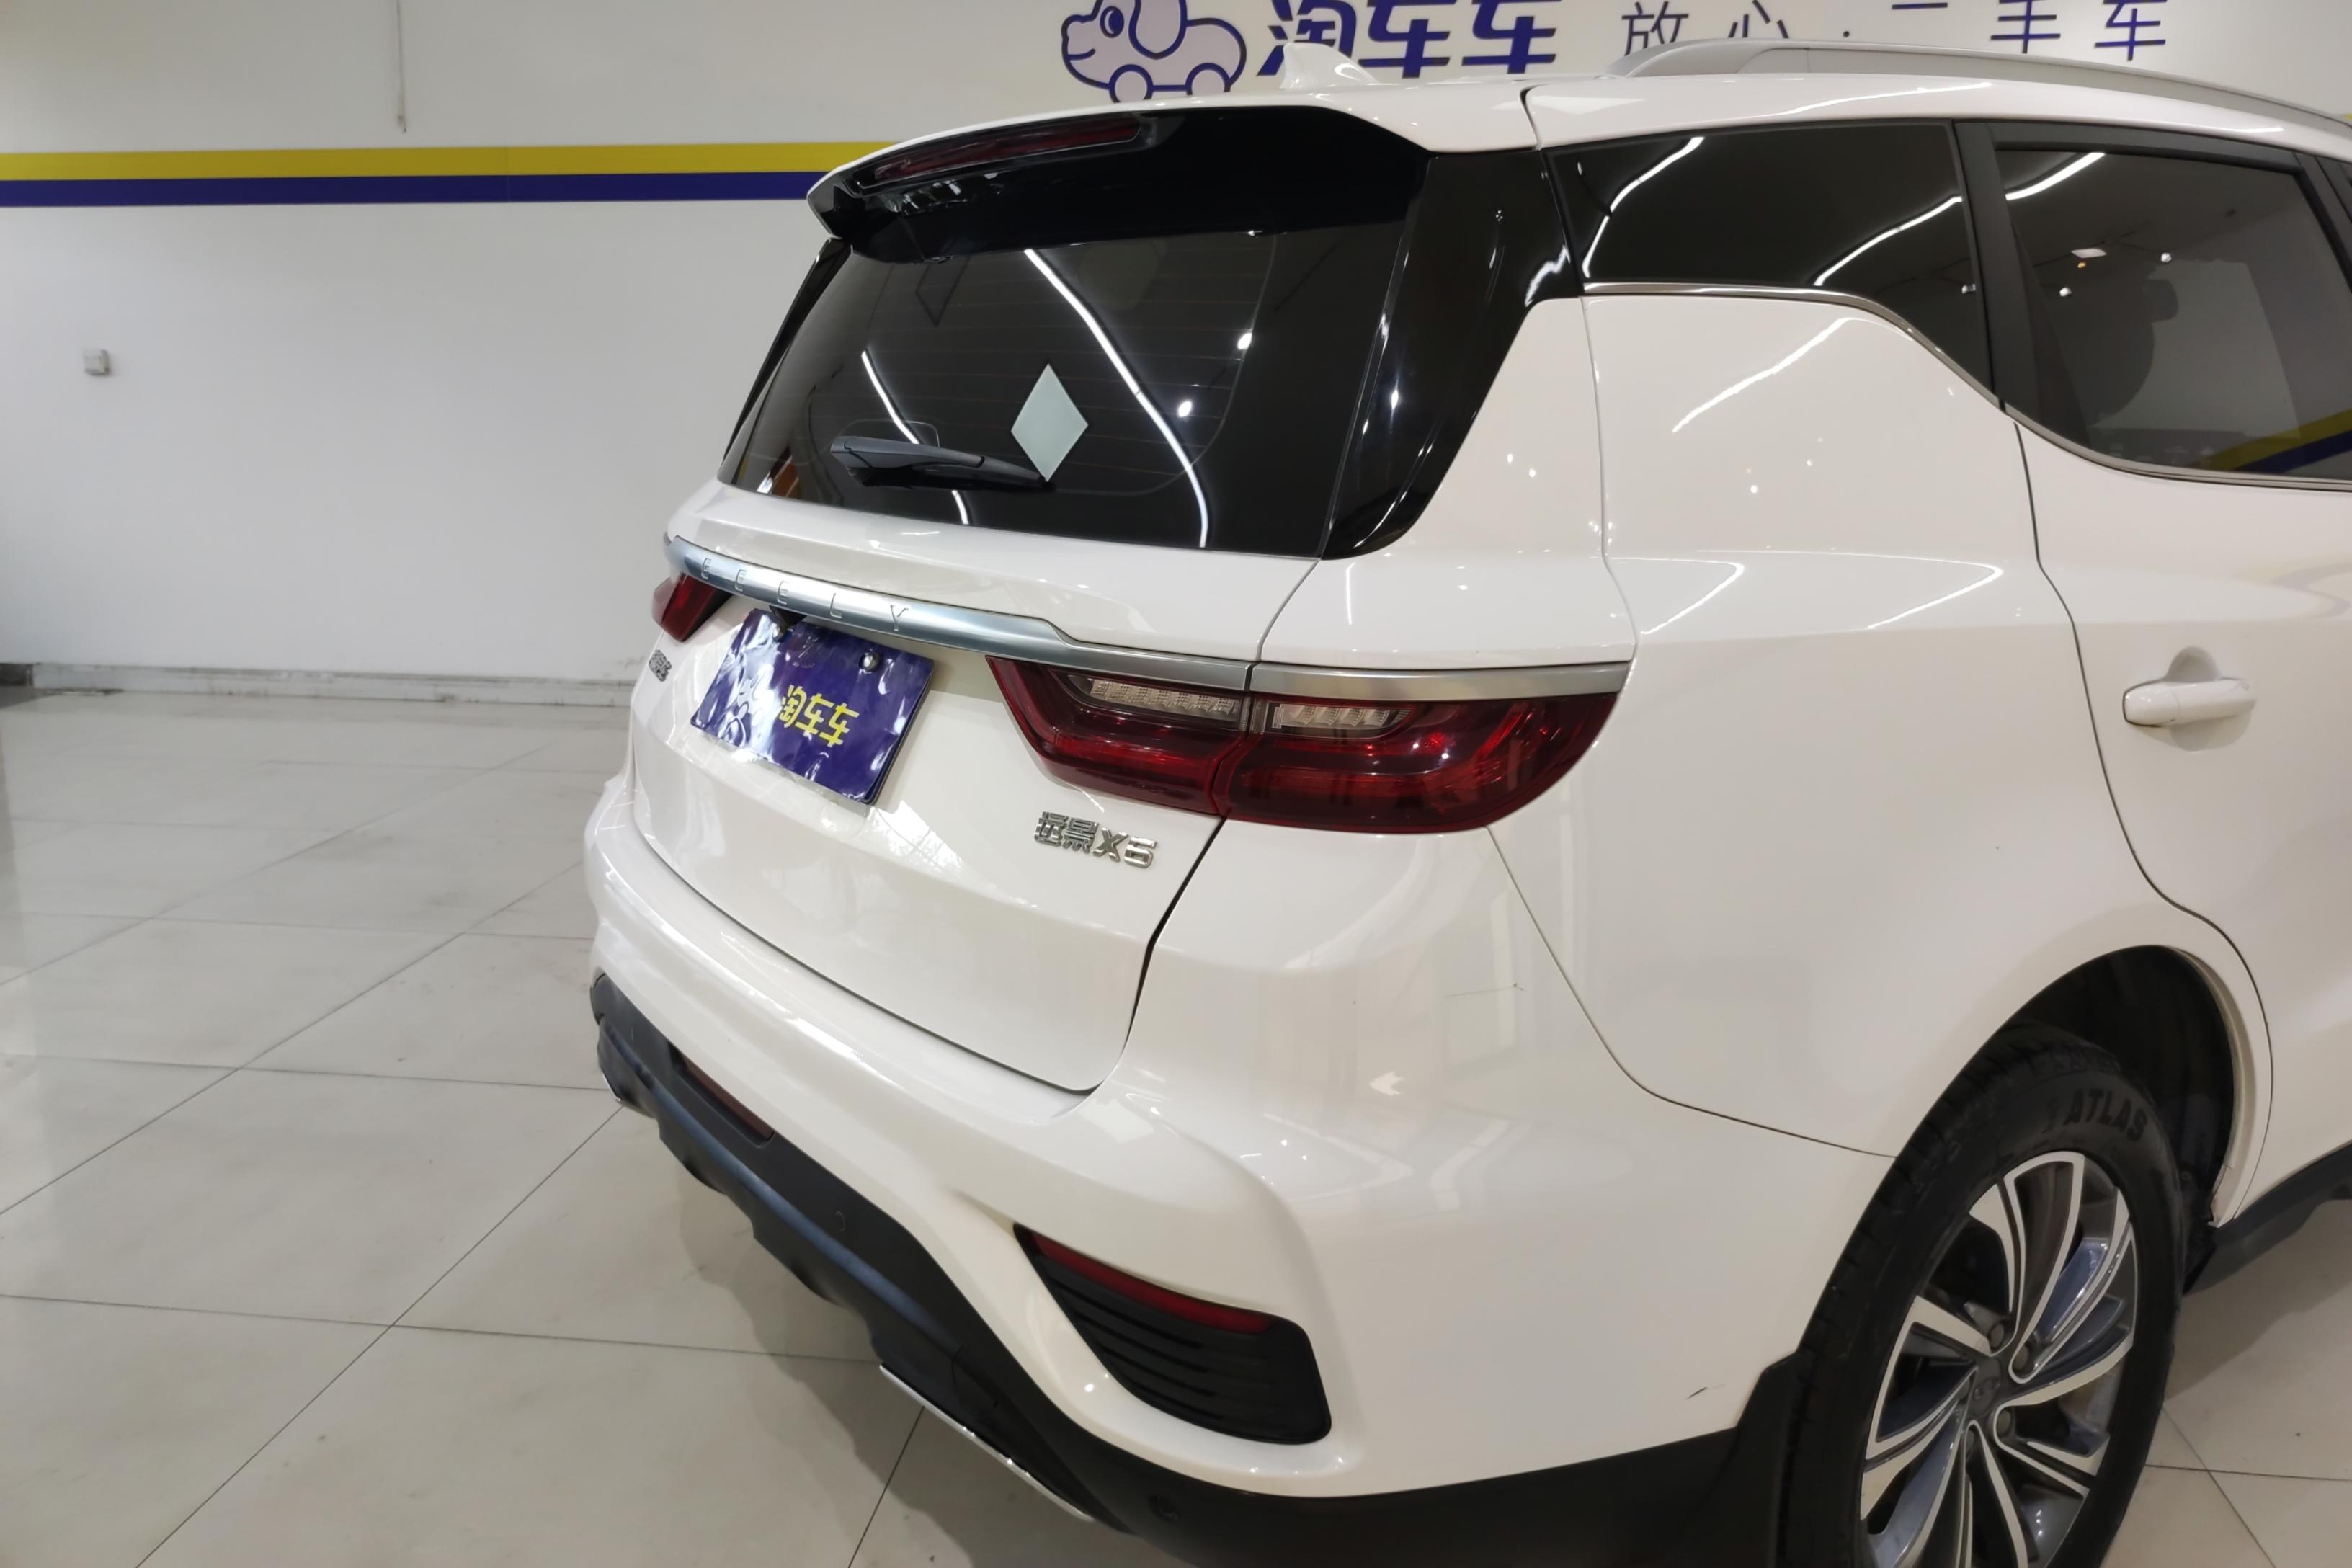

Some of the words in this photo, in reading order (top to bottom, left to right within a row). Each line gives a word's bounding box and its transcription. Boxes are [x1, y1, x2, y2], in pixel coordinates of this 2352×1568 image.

[1257, 0, 1562, 79] 淘车车
[779, 685, 860, 748] 淘车车
[2062, 1088, 2148, 1142] ATLAS
